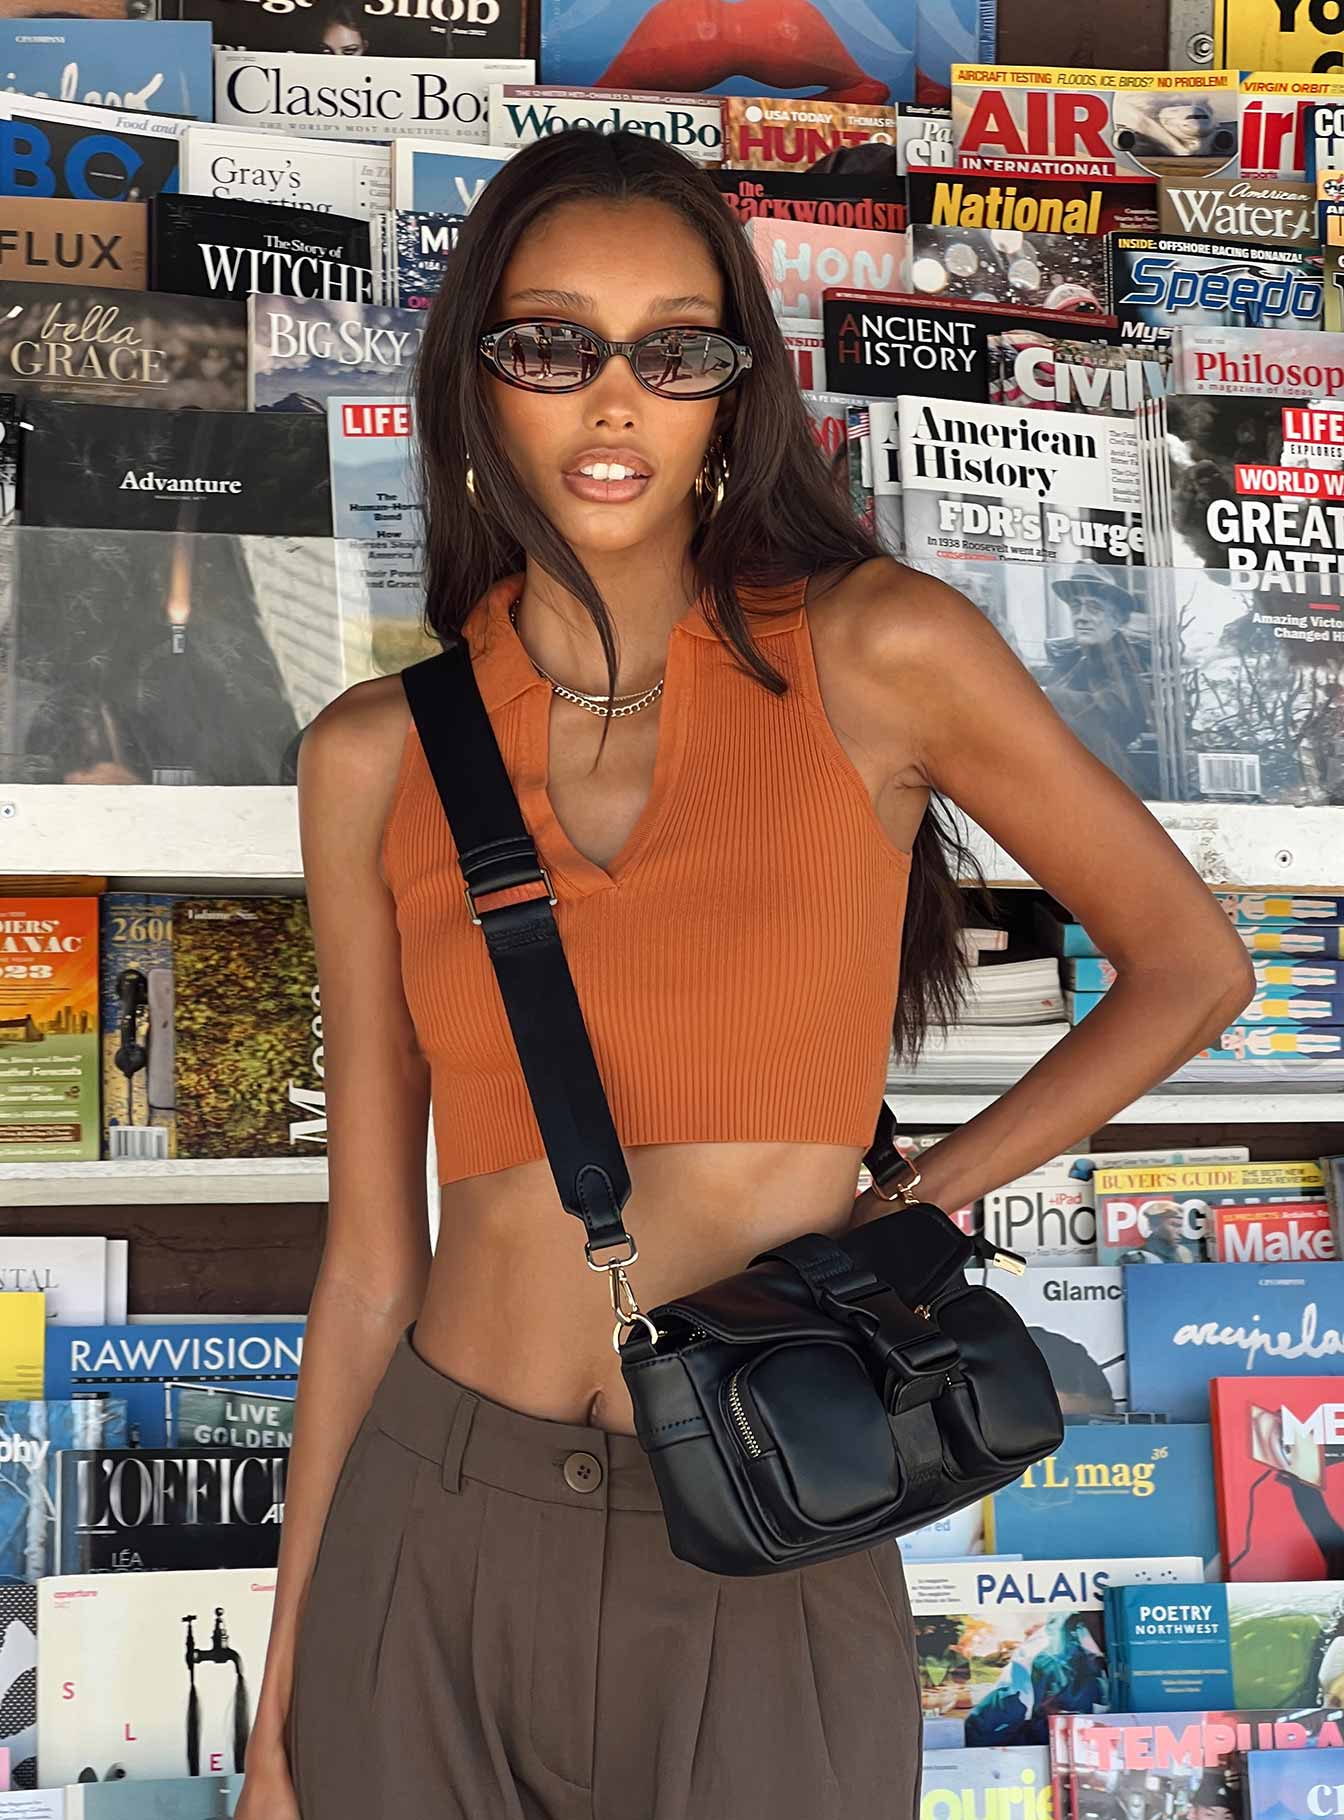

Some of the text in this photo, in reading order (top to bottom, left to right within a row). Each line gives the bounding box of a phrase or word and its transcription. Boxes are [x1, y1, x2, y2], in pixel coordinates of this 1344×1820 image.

[227, 64, 404, 121] Classic
[957, 70, 1008, 82] AIRCRAFT
[1008, 71, 1052, 85] TESTING
[1157, 78, 1173, 90] NO
[1174, 78, 1228, 92] PROBLEM!
[1244, 82, 1330, 94] VIRGIN ORBIT
[116, 116, 178, 137] Food and
[764, 110, 790, 122] USA
[791, 112, 832, 125] TODAY
[959, 89, 1116, 158] AIR
[211, 156, 301, 192] Gray's
[962, 157, 1113, 177] INTERNATIONAL
[932, 182, 1104, 236] National
[0, 229, 122, 269] FLUX
[263, 235, 344, 259] The Story of
[1118, 239, 1303, 263] INSIDE: OFFSHORE RACING BONANZA!
[41, 302, 142, 345] bella
[839, 313, 977, 347] ANCIENT
[267, 312, 410, 366] BIG SKY
[11, 340, 169, 385] GRACE
[839, 341, 978, 374] HISTORY
[344, 406, 410, 436] LIFE
[911, 405, 1099, 459] American
[1284, 410, 1344, 443] LIFE
[1290, 444, 1344, 458] EXPLORES
[118, 470, 244, 494] Advanture
[911, 441, 1060, 498] History
[1239, 468, 1320, 495] WORLD
[376, 493, 397, 501] The
[376, 531, 402, 539] How
[936, 498, 1145, 558] FDR's Purge
[1206, 499, 1344, 551] GREAT
[927, 536, 1058, 559] In 1938 Roosevelt went after
[1228, 547, 1344, 597] BATT
[1251, 612, 1308, 630] Amazing
[1273, 626, 1330, 644] Changed
[0, 964, 54, 980] 23
[1102, 1169, 1239, 1191] BUYER'S GUIDE
[992, 1192, 1097, 1249] iPho
[1223, 1220, 1337, 1263] Make
[71, 1336, 304, 1373] RAWVISION
[226, 1402, 281, 1428] LIVE
[194, 1424, 293, 1450] GOLDEN
[1074, 1462, 1157, 1497] mag
[1151, 1446, 1169, 1461] 36
[112, 1549, 145, 1568] LÉA
[976, 1571, 1110, 1605] PALAIS
[1139, 1604, 1215, 1622] POETRY
[1134, 1623, 1219, 1636] NORTHWEST
[62, 1681, 75, 1700] S
[124, 1723, 137, 1741] L
[210, 1754, 223, 1772] E
